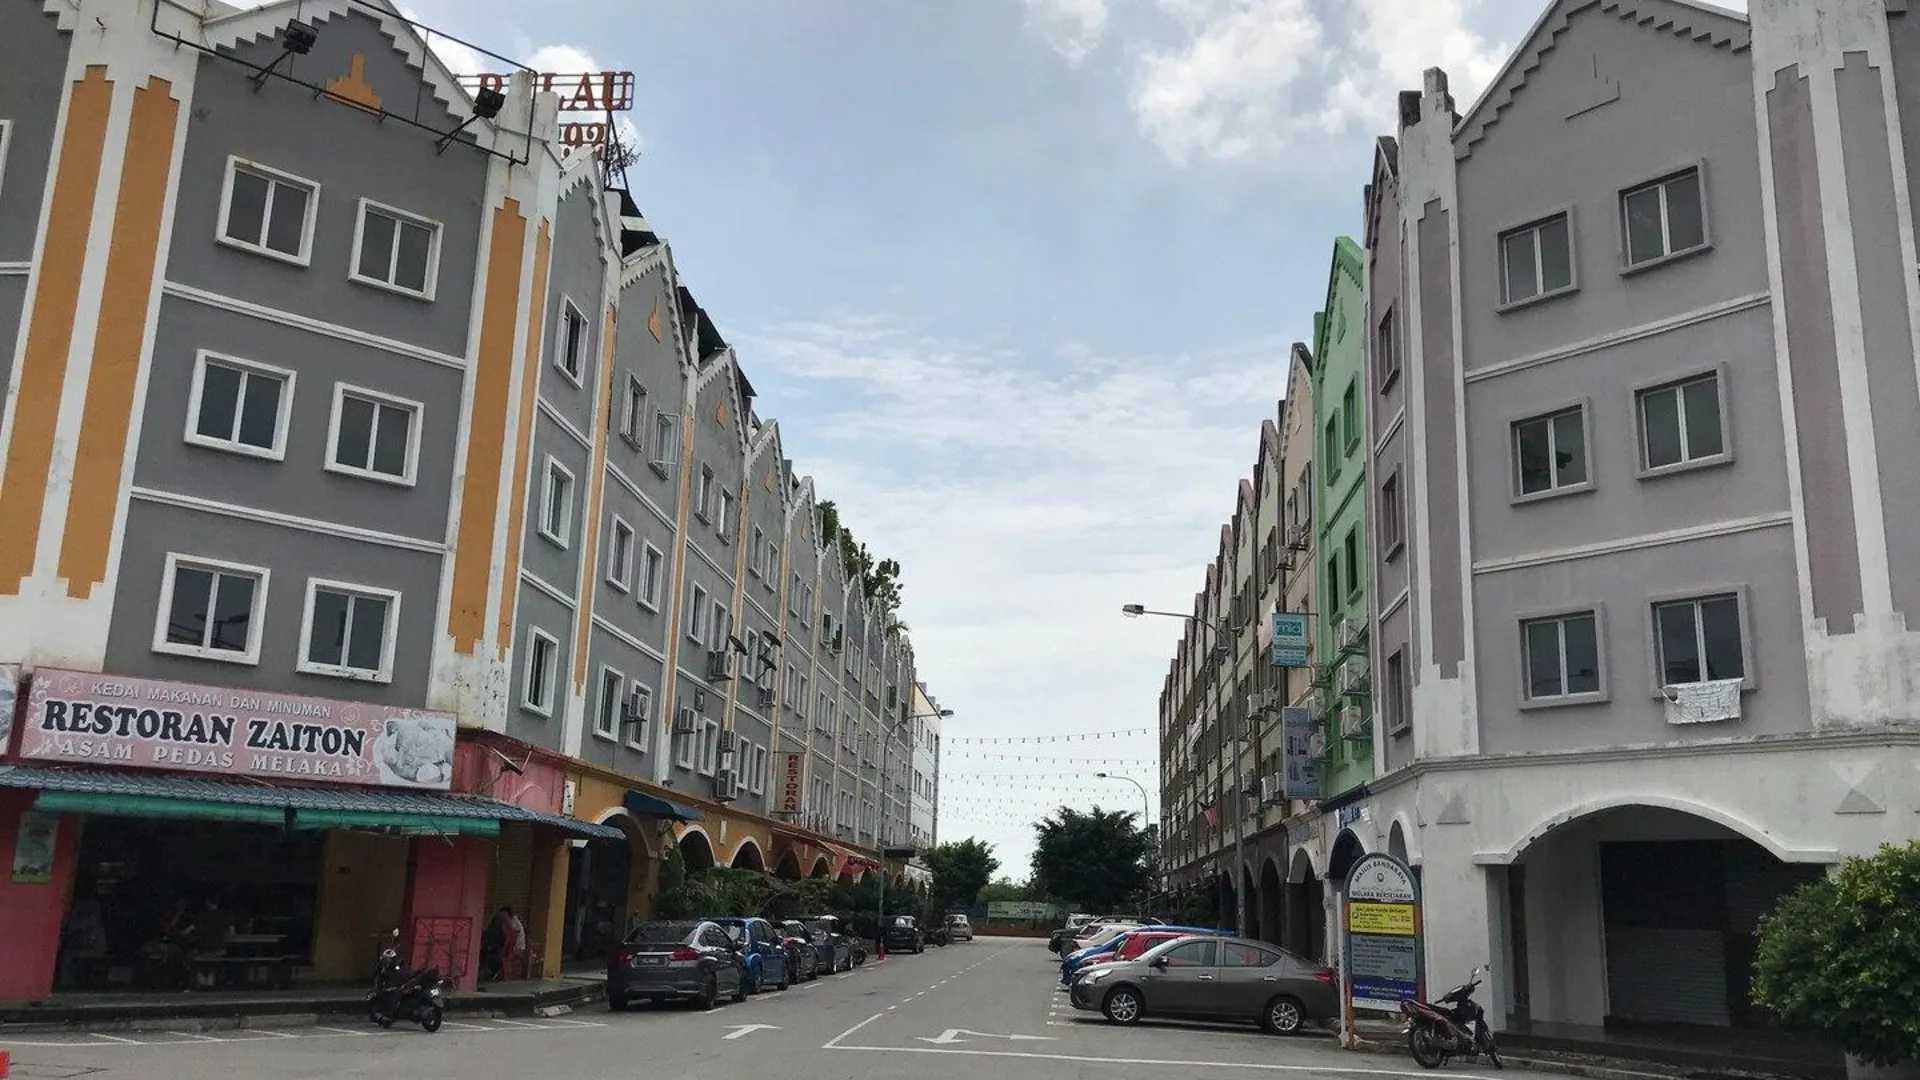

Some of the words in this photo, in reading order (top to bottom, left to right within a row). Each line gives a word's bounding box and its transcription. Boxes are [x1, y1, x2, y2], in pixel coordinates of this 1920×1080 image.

[478, 72, 633, 112] PLAU
[91, 682, 139, 698] KEDAI
[147, 688, 222, 707] MAKANAN
[230, 697, 260, 711] DAN
[267, 700, 332, 718] MINUMAN
[42, 700, 236, 746] RESTORAN
[247, 719, 366, 757] ZAITON
[59, 739, 134, 760] ASAM
[152, 746, 235, 768] PEDAS
[250, 754, 343, 777] MELAKA
[784, 754, 799, 810] RESTORAN
